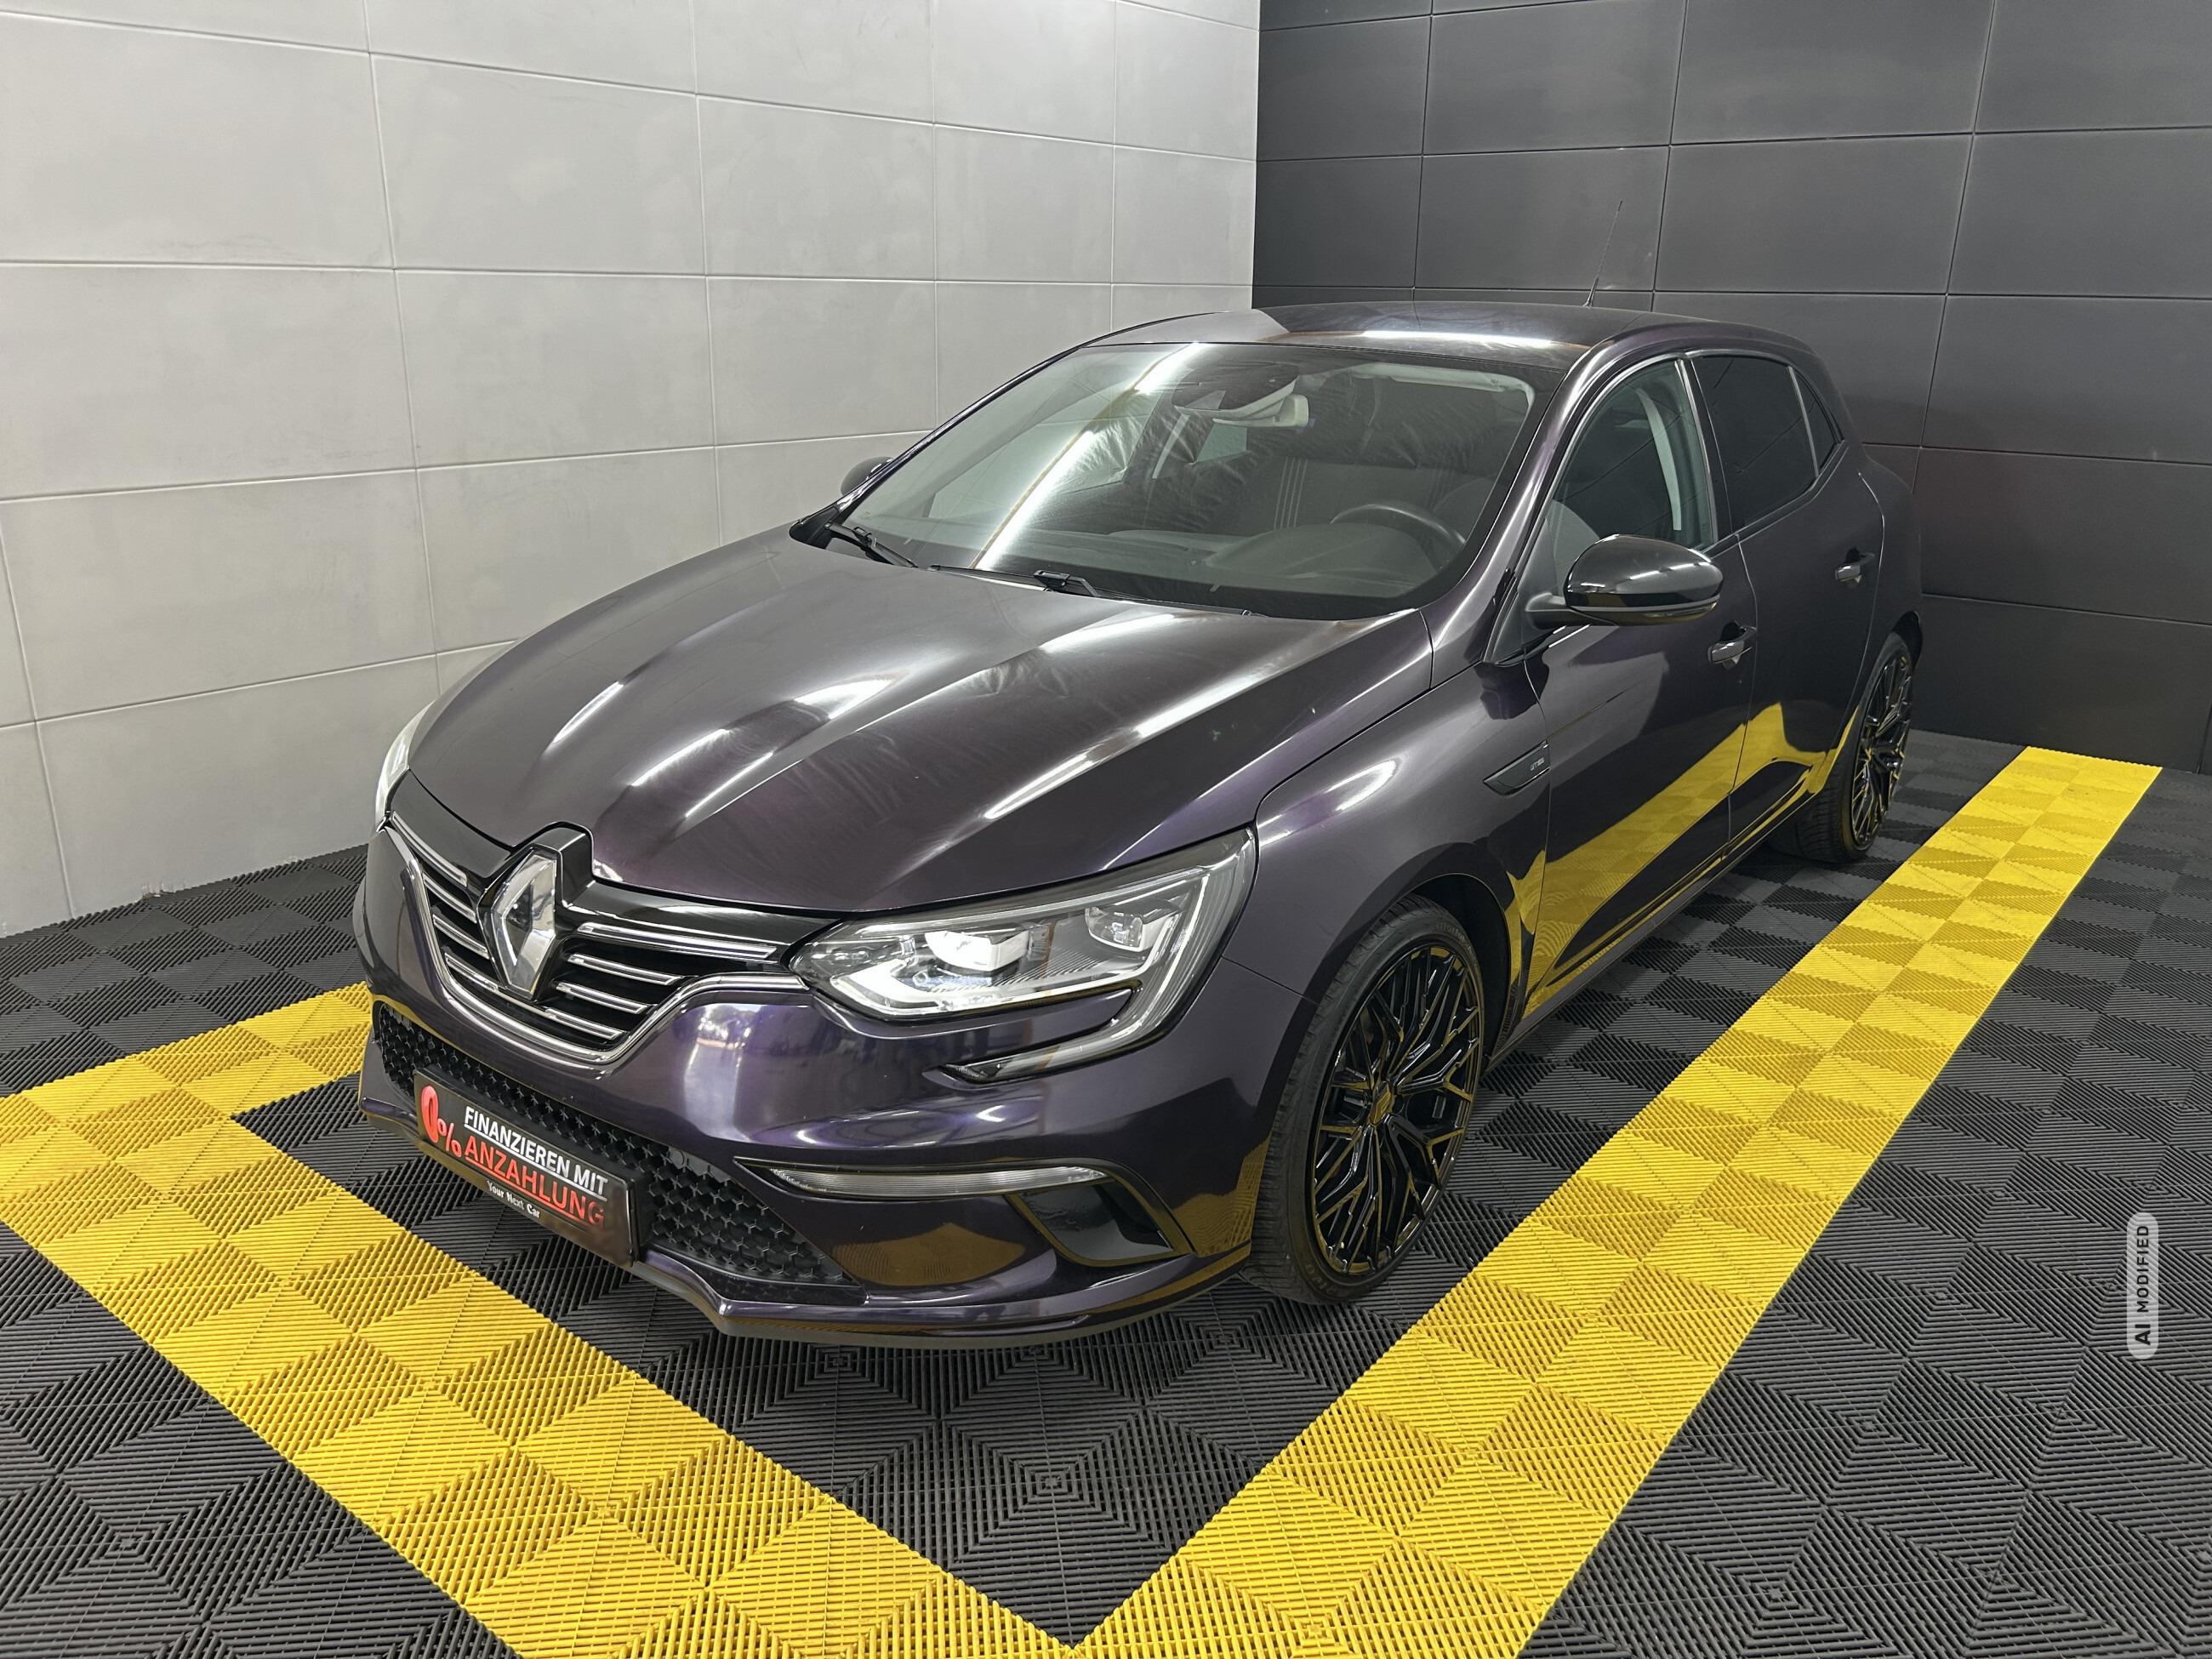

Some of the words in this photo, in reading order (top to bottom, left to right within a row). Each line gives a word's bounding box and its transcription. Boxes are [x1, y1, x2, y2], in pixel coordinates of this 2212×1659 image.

[420, 1085, 462, 1158] 0%
[465, 1136, 605, 1229] ANZAHLUNG
[465, 1106, 571, 1180] FINANZIEREN
[574, 1165, 608, 1194] MIT
[487, 1180, 505, 1201] Your
[506, 1190, 525, 1211] Next
[527, 1201, 541, 1219] Car
